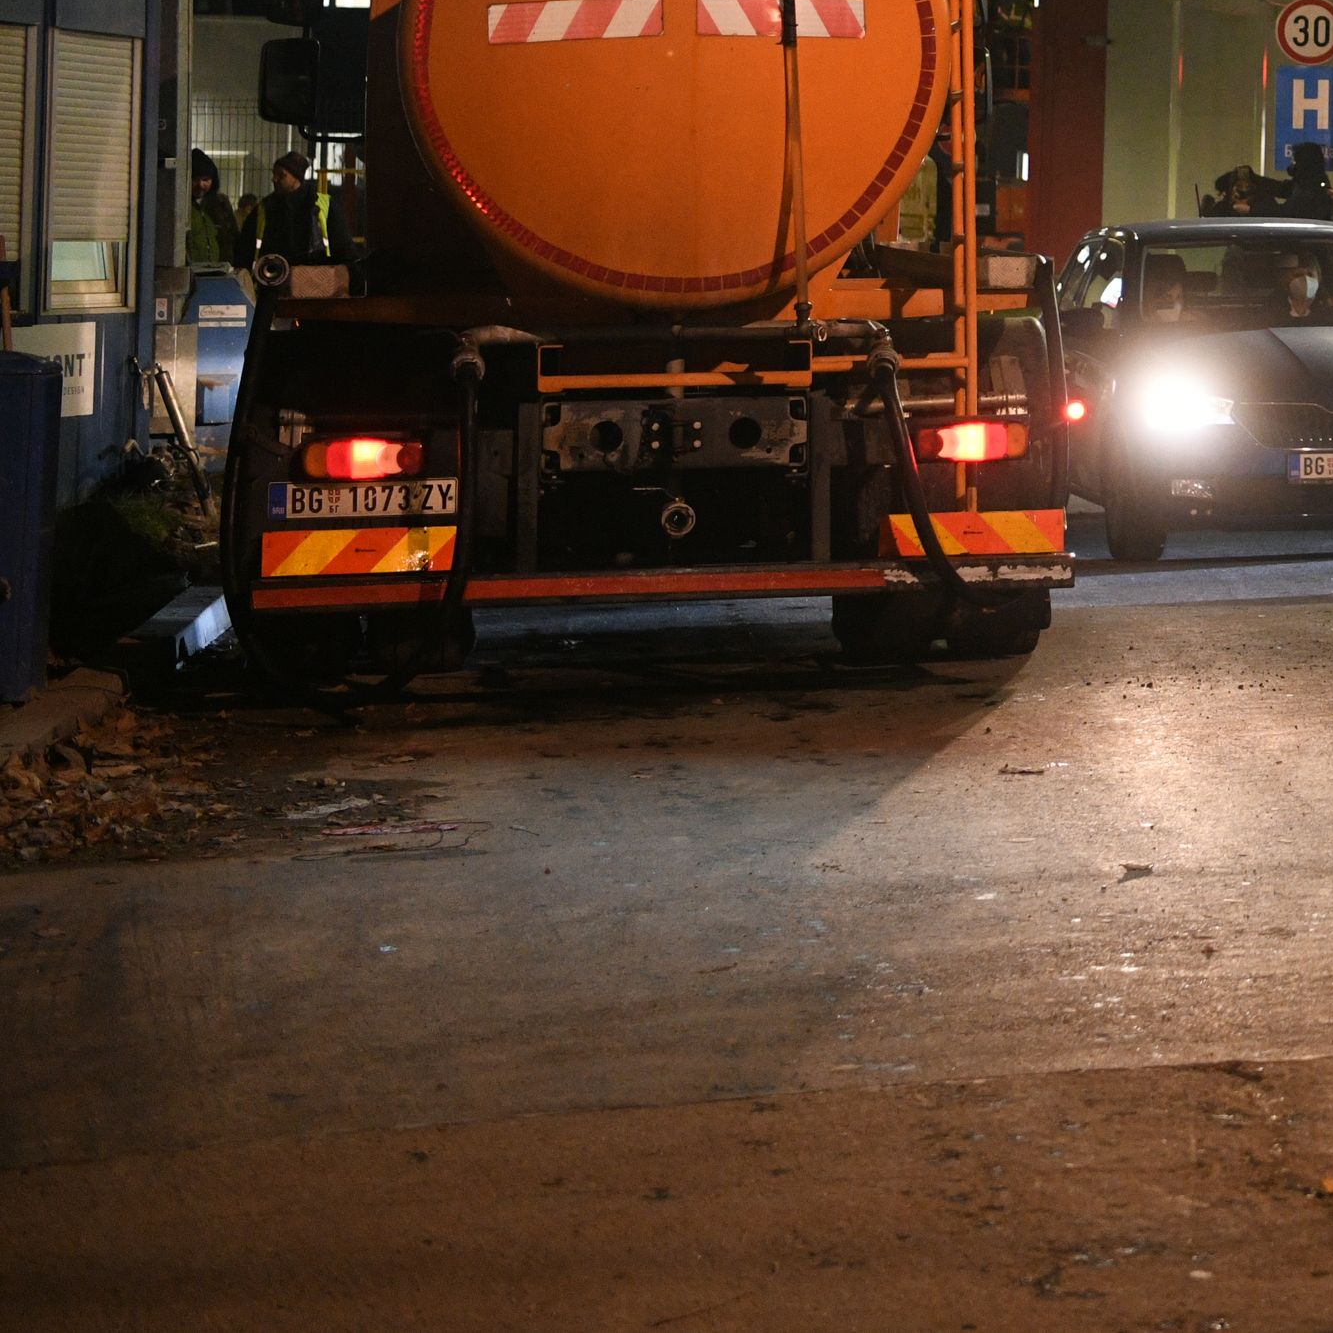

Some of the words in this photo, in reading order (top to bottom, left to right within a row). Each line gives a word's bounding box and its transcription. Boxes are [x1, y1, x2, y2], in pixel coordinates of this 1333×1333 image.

[1292, 15, 1330, 47] 30
[1292, 78, 1330, 130] H
[1304, 457, 1325, 475] BG
[291, 487, 323, 514] BG
